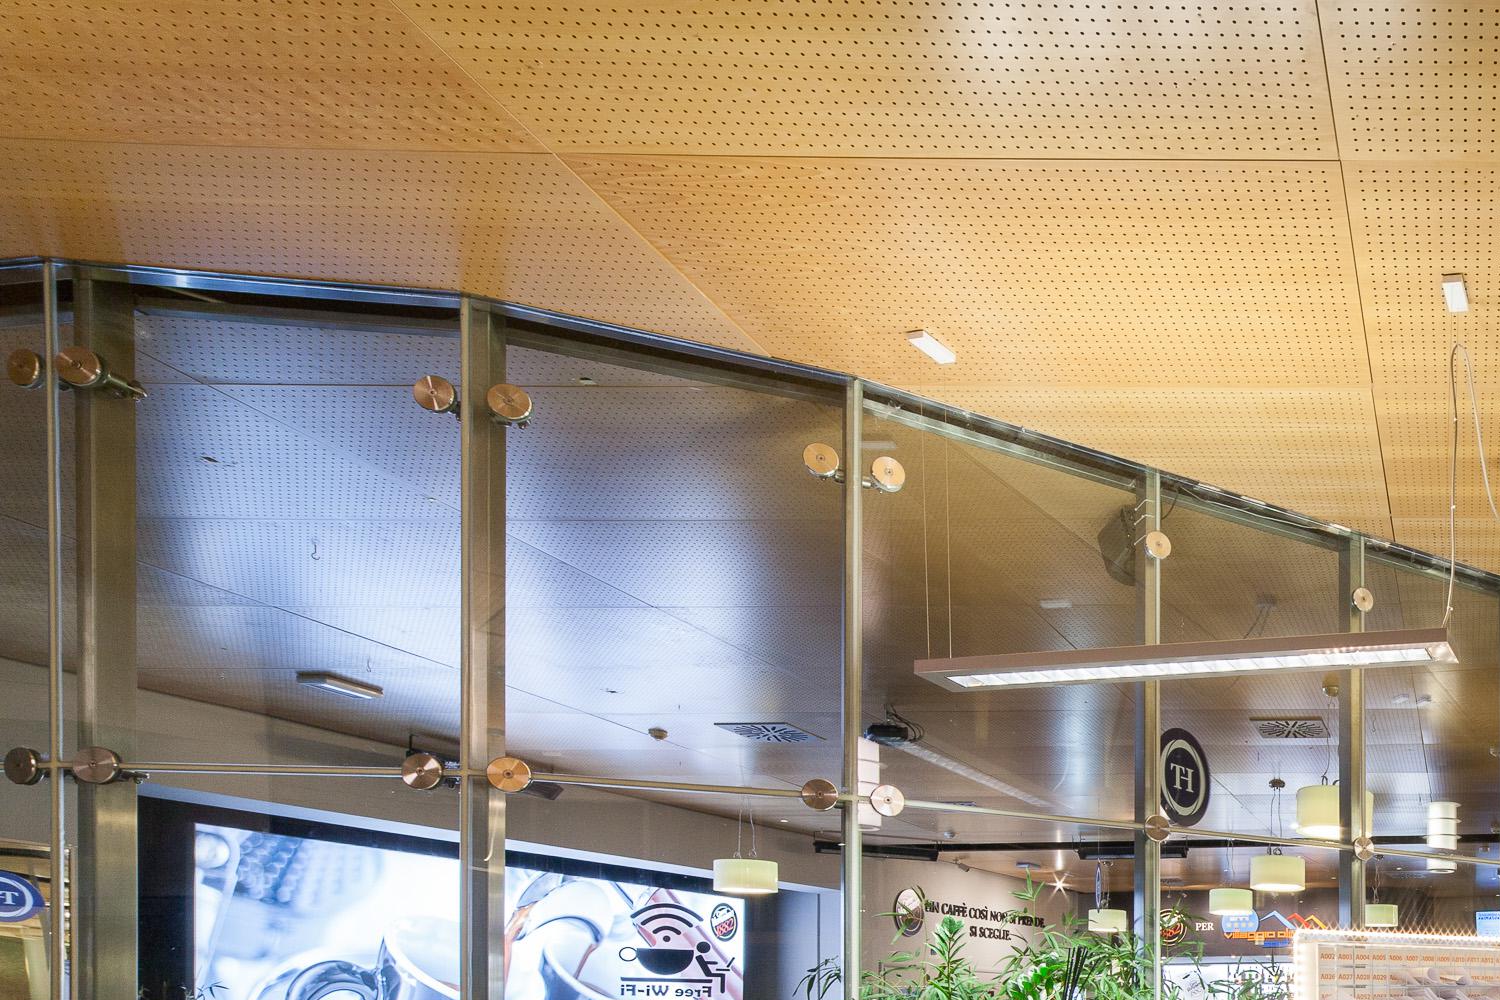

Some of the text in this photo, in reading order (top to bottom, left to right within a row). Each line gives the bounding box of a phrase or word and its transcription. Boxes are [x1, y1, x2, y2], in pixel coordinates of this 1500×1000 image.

[1170, 763, 1194, 793] TH
[941, 902, 968, 918] CAFFÈ
[968, 906, 988, 921] COSÌ
[969, 926, 978, 937] SI
[1194, 922, 1215, 932] PER
